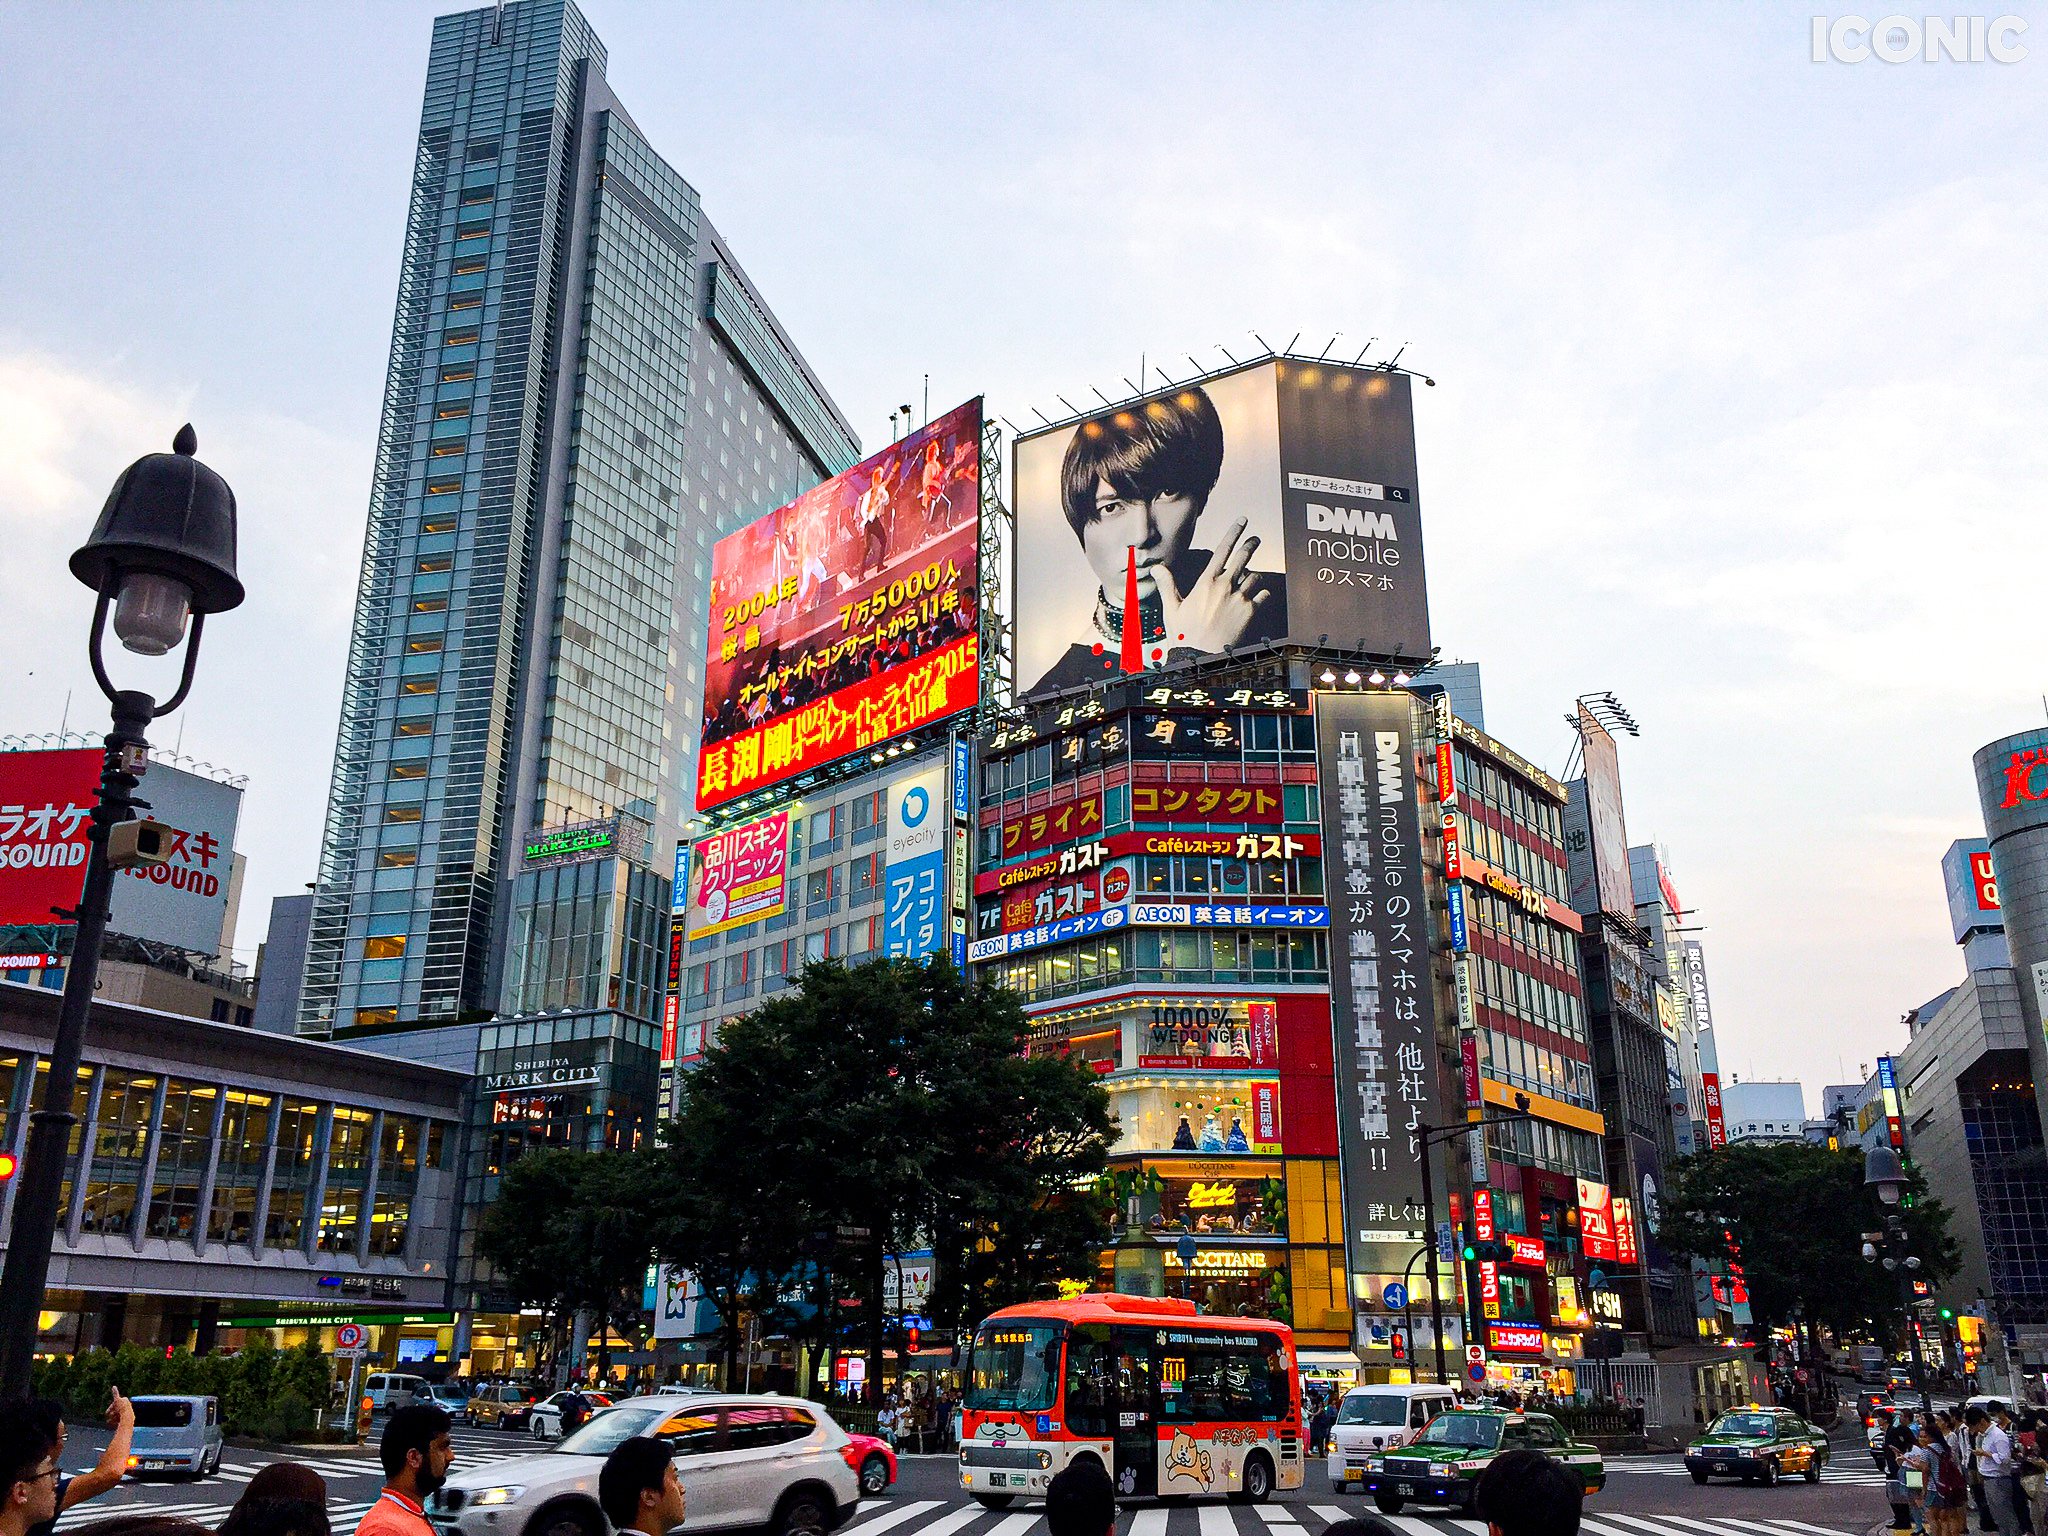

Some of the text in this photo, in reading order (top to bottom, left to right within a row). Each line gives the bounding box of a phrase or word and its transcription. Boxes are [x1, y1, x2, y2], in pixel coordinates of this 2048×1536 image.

[1306, 503, 1398, 541] DMM
[1308, 538, 1399, 566] mobile
[838, 558, 961, 631] 7万5000人
[1317, 568, 1395, 591] のスマホ
[722, 575, 798, 632] 2004年
[720, 625, 761, 663] 桜島
[738, 589, 960, 704] オールナイトコンサートから11年
[855, 677, 948, 749] in 富士山麓
[700, 718, 794, 798] 長渕剛
[1374, 731, 1404, 804] DMM
[1133, 788, 1277, 814] コンタクト
[1005, 798, 1101, 849] プライス
[171, 828, 220, 869] スキ
[527, 833, 610, 855] MARK CITY
[705, 821, 786, 870] 品川スキン
[893, 828, 937, 854] eyecity
[1235, 833, 1304, 859] ガスト
[1379, 806, 1407, 887] mobile
[1446, 840, 1458, 873] ガスト
[704, 846, 784, 895] クリニック
[1059, 841, 1109, 876] ガスト
[1034, 882, 1095, 925] ガスト
[1106, 881, 1128, 894] ガスト
[1521, 886, 1549, 921] ガスト
[980, 906, 1002, 931] 7F
[1136, 906, 1325, 925] AEON 英会話イーオン
[971, 937, 1005, 958] AEON
[1010, 916, 1099, 951] 英会話イーオン
[1688, 948, 1711, 1032] BIC CAMERA
[1152, 1006, 1235, 1030] 1000%
[485, 1065, 602, 1089] MARK CITY
[514, 1057, 570, 1071] SHIBUYA
[1258, 1088, 1274, 1138] 毎日開催
[1367, 1202, 1427, 1222] 詳しくは
[1582, 1210, 1608, 1235] アコム
[1164, 1251, 1267, 1268] L'CCITANE
[1199, 1269, 1250, 1277] PROVENCE
[310, 1317, 332, 1325] MARK
[334, 1316, 354, 1324] CITY
[1194, 1336, 1224, 1347] community
[1225, 1337, 1235, 1345] bus
